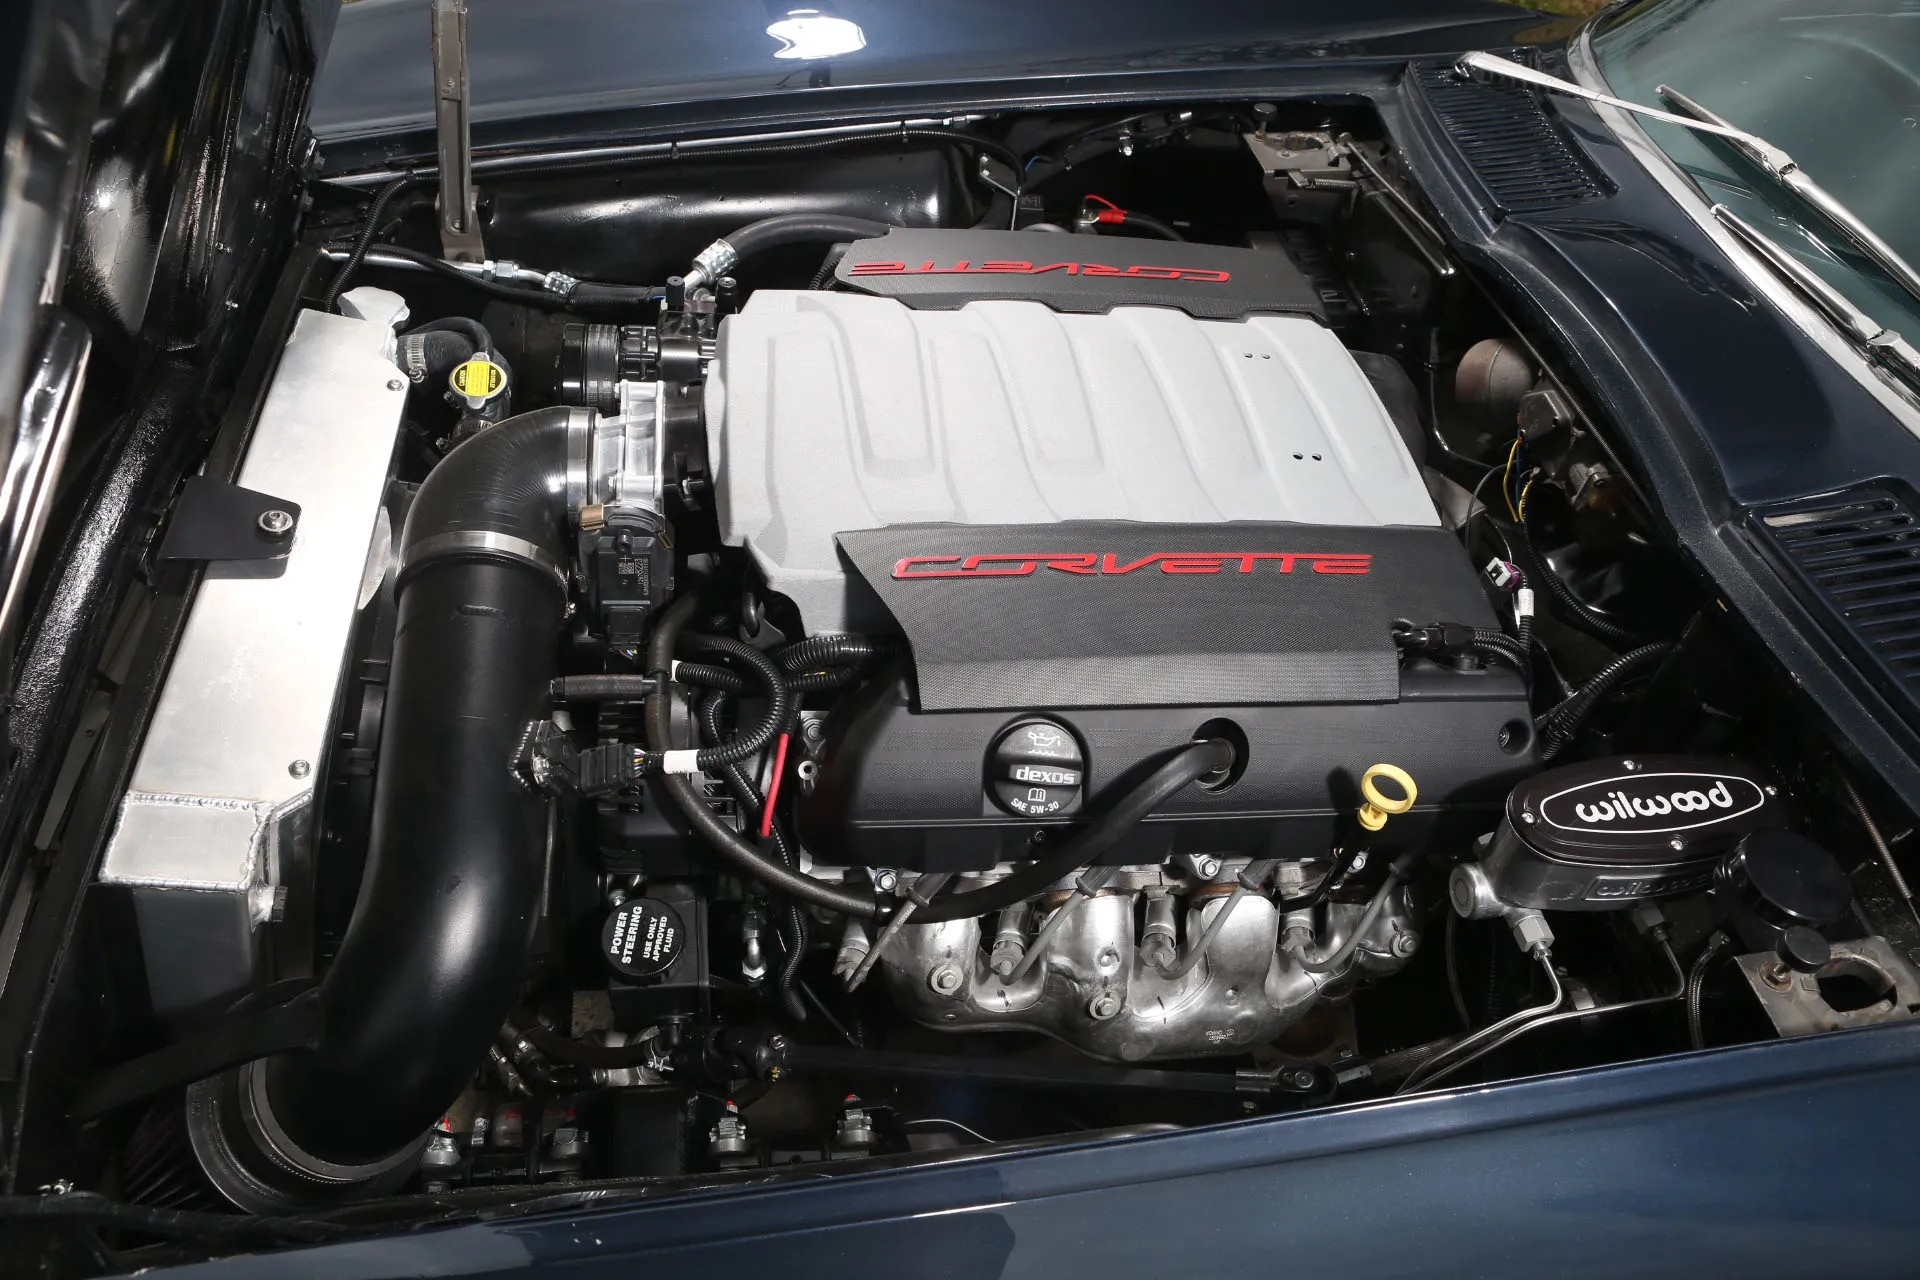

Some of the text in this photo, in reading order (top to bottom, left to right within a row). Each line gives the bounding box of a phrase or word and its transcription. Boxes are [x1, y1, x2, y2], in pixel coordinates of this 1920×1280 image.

[848, 261, 1230, 282] CORVETTE
[891, 553, 1374, 578] CORVETTE
[1016, 766, 1075, 784] dexos
[1011, 798, 1059, 813] SAE 5W-30
[1575, 781, 1733, 822] wilwood
[610, 912, 628, 954] POWER
[621, 906, 643, 964] STEERING
[643, 917, 657, 958] USE ONLY
[652, 916, 668, 962] APPROVED
[663, 928, 674, 953] FLUID
